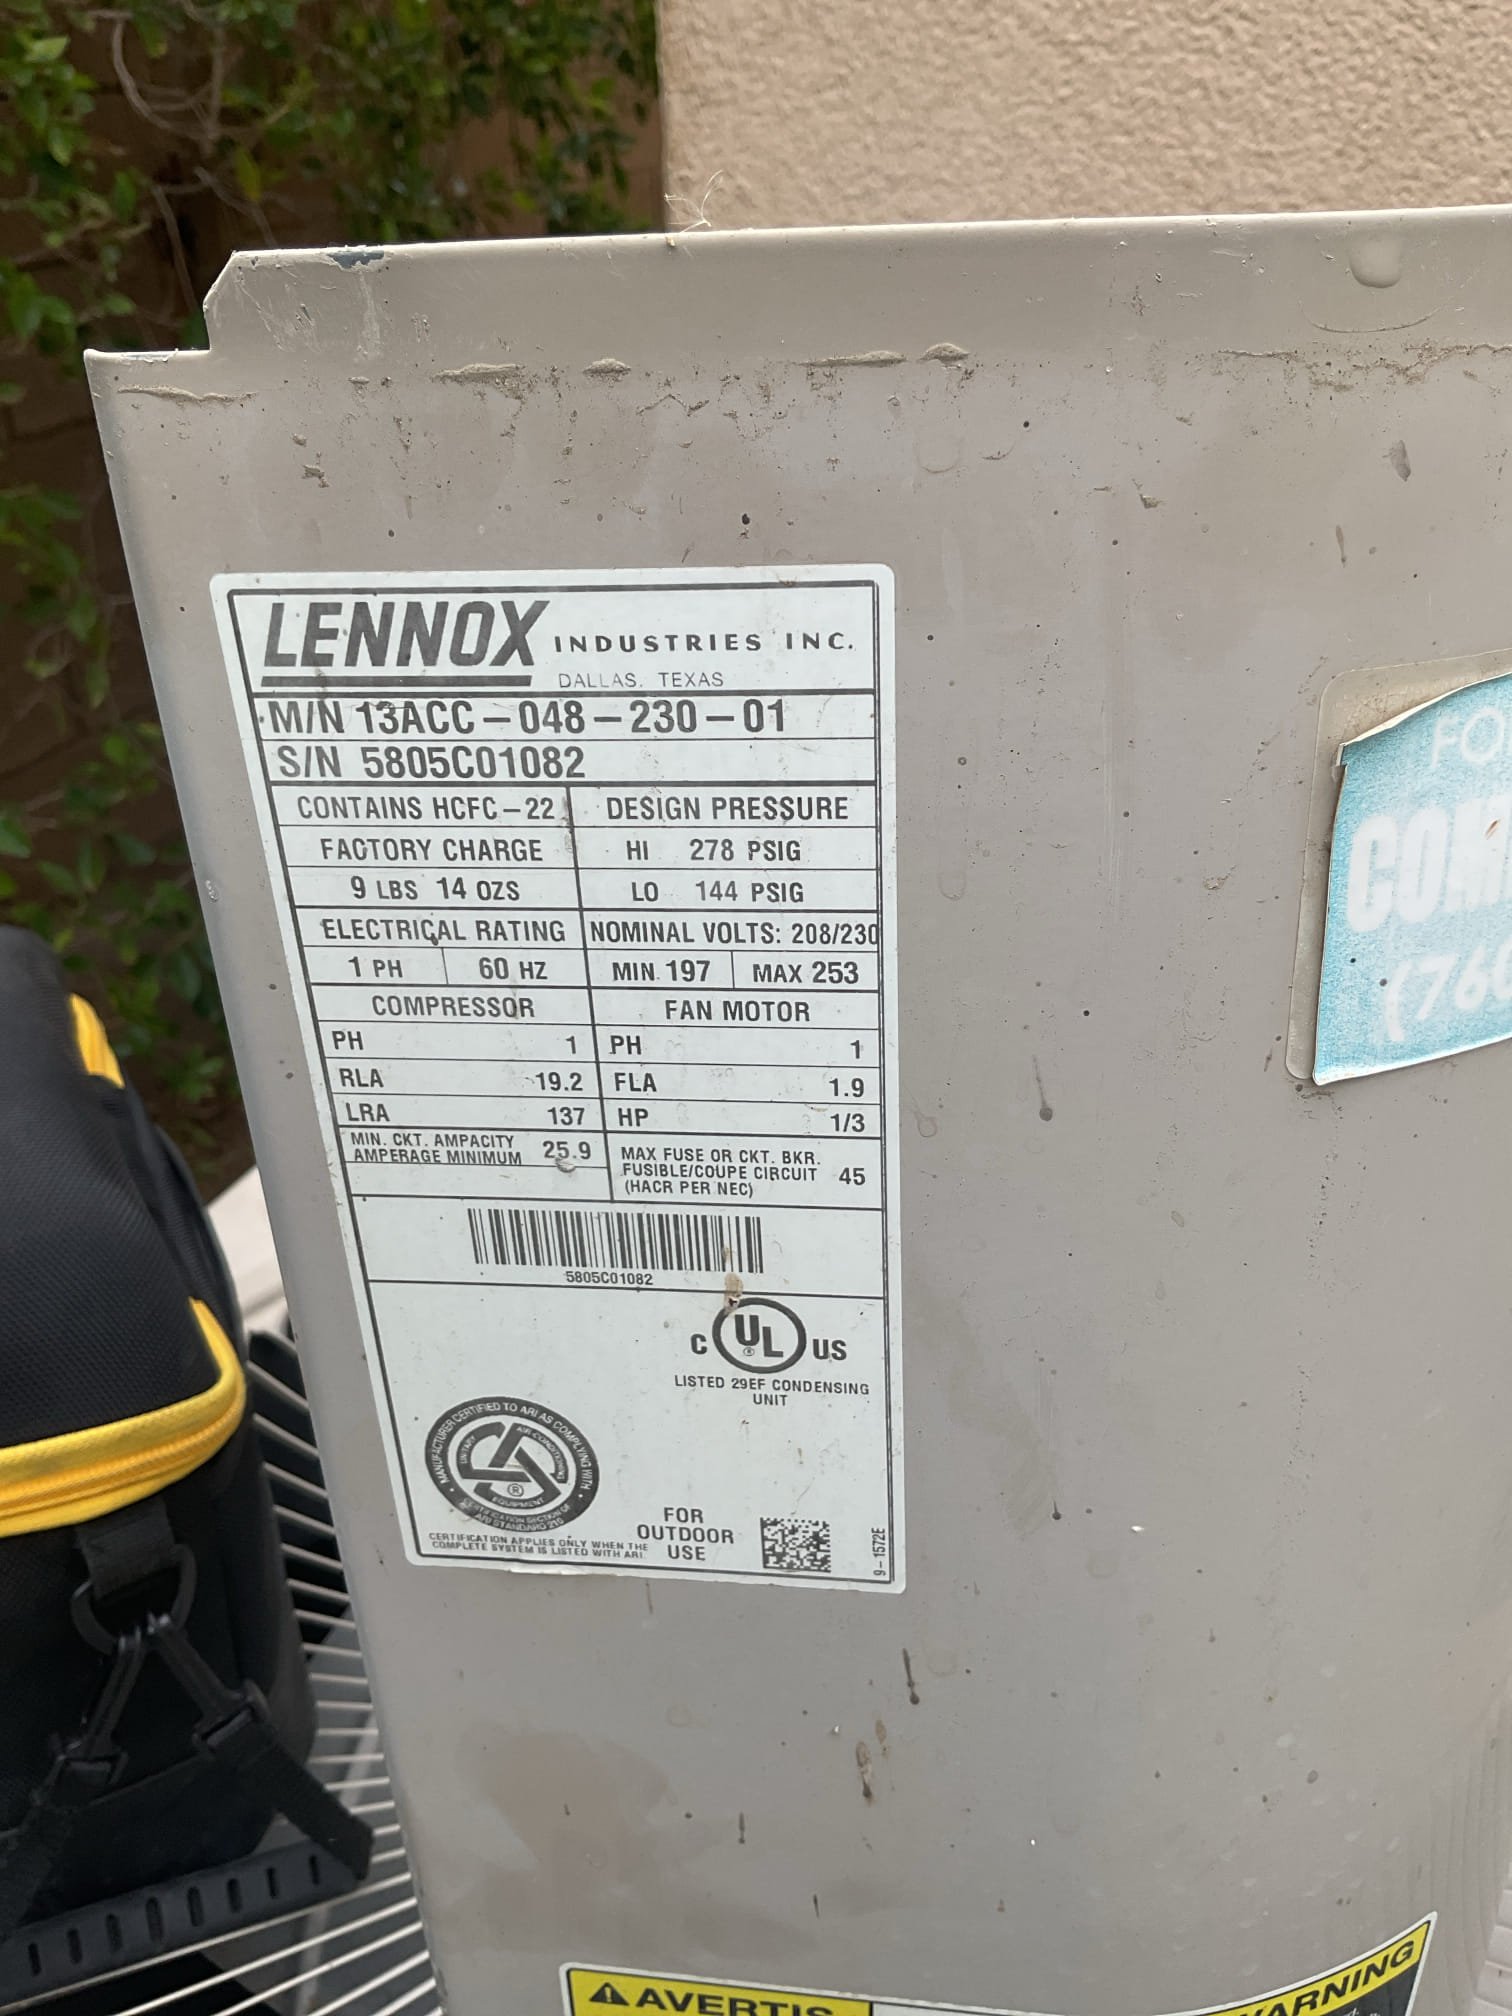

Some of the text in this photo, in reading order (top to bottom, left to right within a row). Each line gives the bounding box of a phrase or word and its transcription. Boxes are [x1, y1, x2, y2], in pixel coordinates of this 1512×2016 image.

[264, 600, 854, 667] LENNOX INDUSTRIES INC.
[658, 671, 724, 687] TEXAS
[268, 700, 345, 733] M/N
[277, 745, 585, 778] S/N 5805C01082
[299, 796, 423, 820] CONTAINS
[606, 796, 849, 821] DESIGN PRESSURE
[320, 838, 543, 861] FACTORY CHARGE
[626, 838, 801, 861] HI 278 PSIG
[350, 875, 521, 901] 9 LBS 14 OZS
[631, 880, 804, 903] LO 144 PSIG
[321, 918, 566, 942] ELECTRICAL RATING
[590, 921, 879, 945] NOMINAL VOLTS: 208/230
[348, 956, 403, 978] 1 PH
[478, 957, 548, 980] 60 HZ
[665, 959, 711, 982] 197
[752, 961, 859, 985] MAX 253
[371, 995, 535, 1018] COMPRESSOR
[665, 1000, 811, 1022] FAN MOTOR
[331, 1031, 577, 1054] PH 1
[610, 1035, 861, 1059] PH 1
[339, 1068, 583, 1091] RLA 19.2
[614, 1073, 865, 1097] FLA 1.9
[345, 1103, 585, 1126] LRA 137
[618, 1108, 866, 1132] HP 1/3
[351, 1133, 591, 1160] MIN. CKT. AMPACITY 25.9
[354, 1149, 522, 1165] AMPERAGE MINIMUM
[621, 1147, 821, 1165] MAX FUSE OR CKT. BKR.
[623, 1164, 817, 1181] FUSIBLE/COUPE CIRCUIT
[839, 1167, 866, 1186] 45
[624, 1181, 753, 1198] (HACR PER NEC)
[566, 1271, 653, 1286] 5805C01082
[691, 1314, 847, 1360] C UL US
[675, 1375, 869, 1395] LISTED 29EF CONDENSING
[753, 1393, 787, 1406] UNIT
[431, 1402, 593, 1490] MANUFACTURER CERTIFIED TO ARI AS COMPLYING WITH
[663, 1507, 704, 1524] FOR
[429, 1532, 649, 1551] CERTIFICATION APPLIES ONLY WHEN THE
[637, 1525, 734, 1544] OUTDOOR
[432, 1541, 487, 1551] COMPLETE
[491, 1544, 534, 1554] SYSTEM
[538, 1546, 547, 1554] IS
[551, 1547, 588, 1556] LISTED
[592, 1549, 621, 1558] WITH
[668, 1545, 706, 1561] USE
